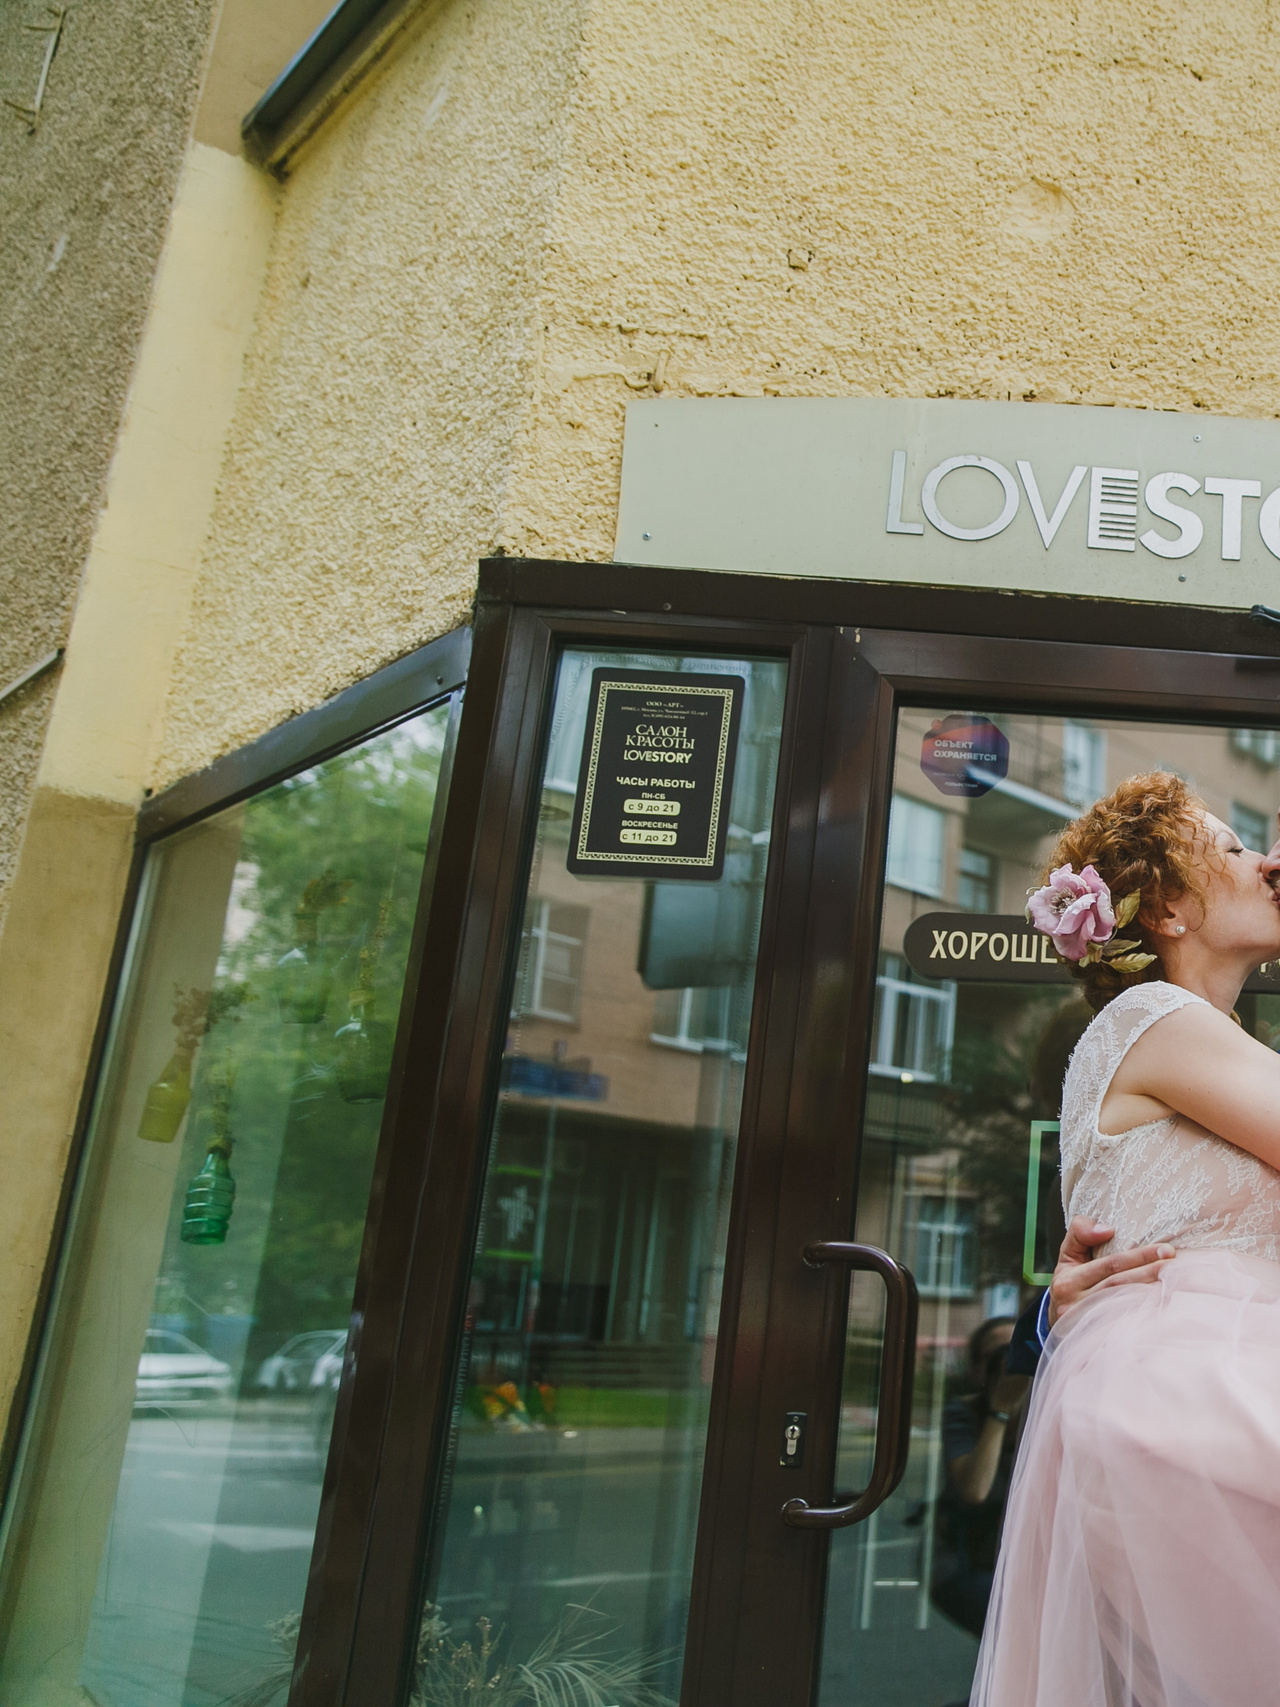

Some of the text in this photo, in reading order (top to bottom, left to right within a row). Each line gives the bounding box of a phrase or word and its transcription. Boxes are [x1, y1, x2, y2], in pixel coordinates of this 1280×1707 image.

[635, 724, 688, 738] САЛОН
[625, 734, 696, 750] КРАСОТЫ
[934, 739, 974, 750] ОБЪЕКТ
[623, 749, 693, 764] LOVESTORY
[933, 750, 997, 762] ОХРАНЯЕТСЯ
[616, 776, 696, 789] ЧАСЫ РАБОТЫ
[641, 792, 666, 800] ПН-СБ
[628, 802, 675, 813] с 9 до 21
[621, 820, 679, 830] ВОСКРЕСЕНЬЕ
[631, 832, 642, 841] 11
[644, 834, 659, 843] до
[662, 834, 674, 842] 21
[929, 930, 1058, 964] ХОРОШЕ
